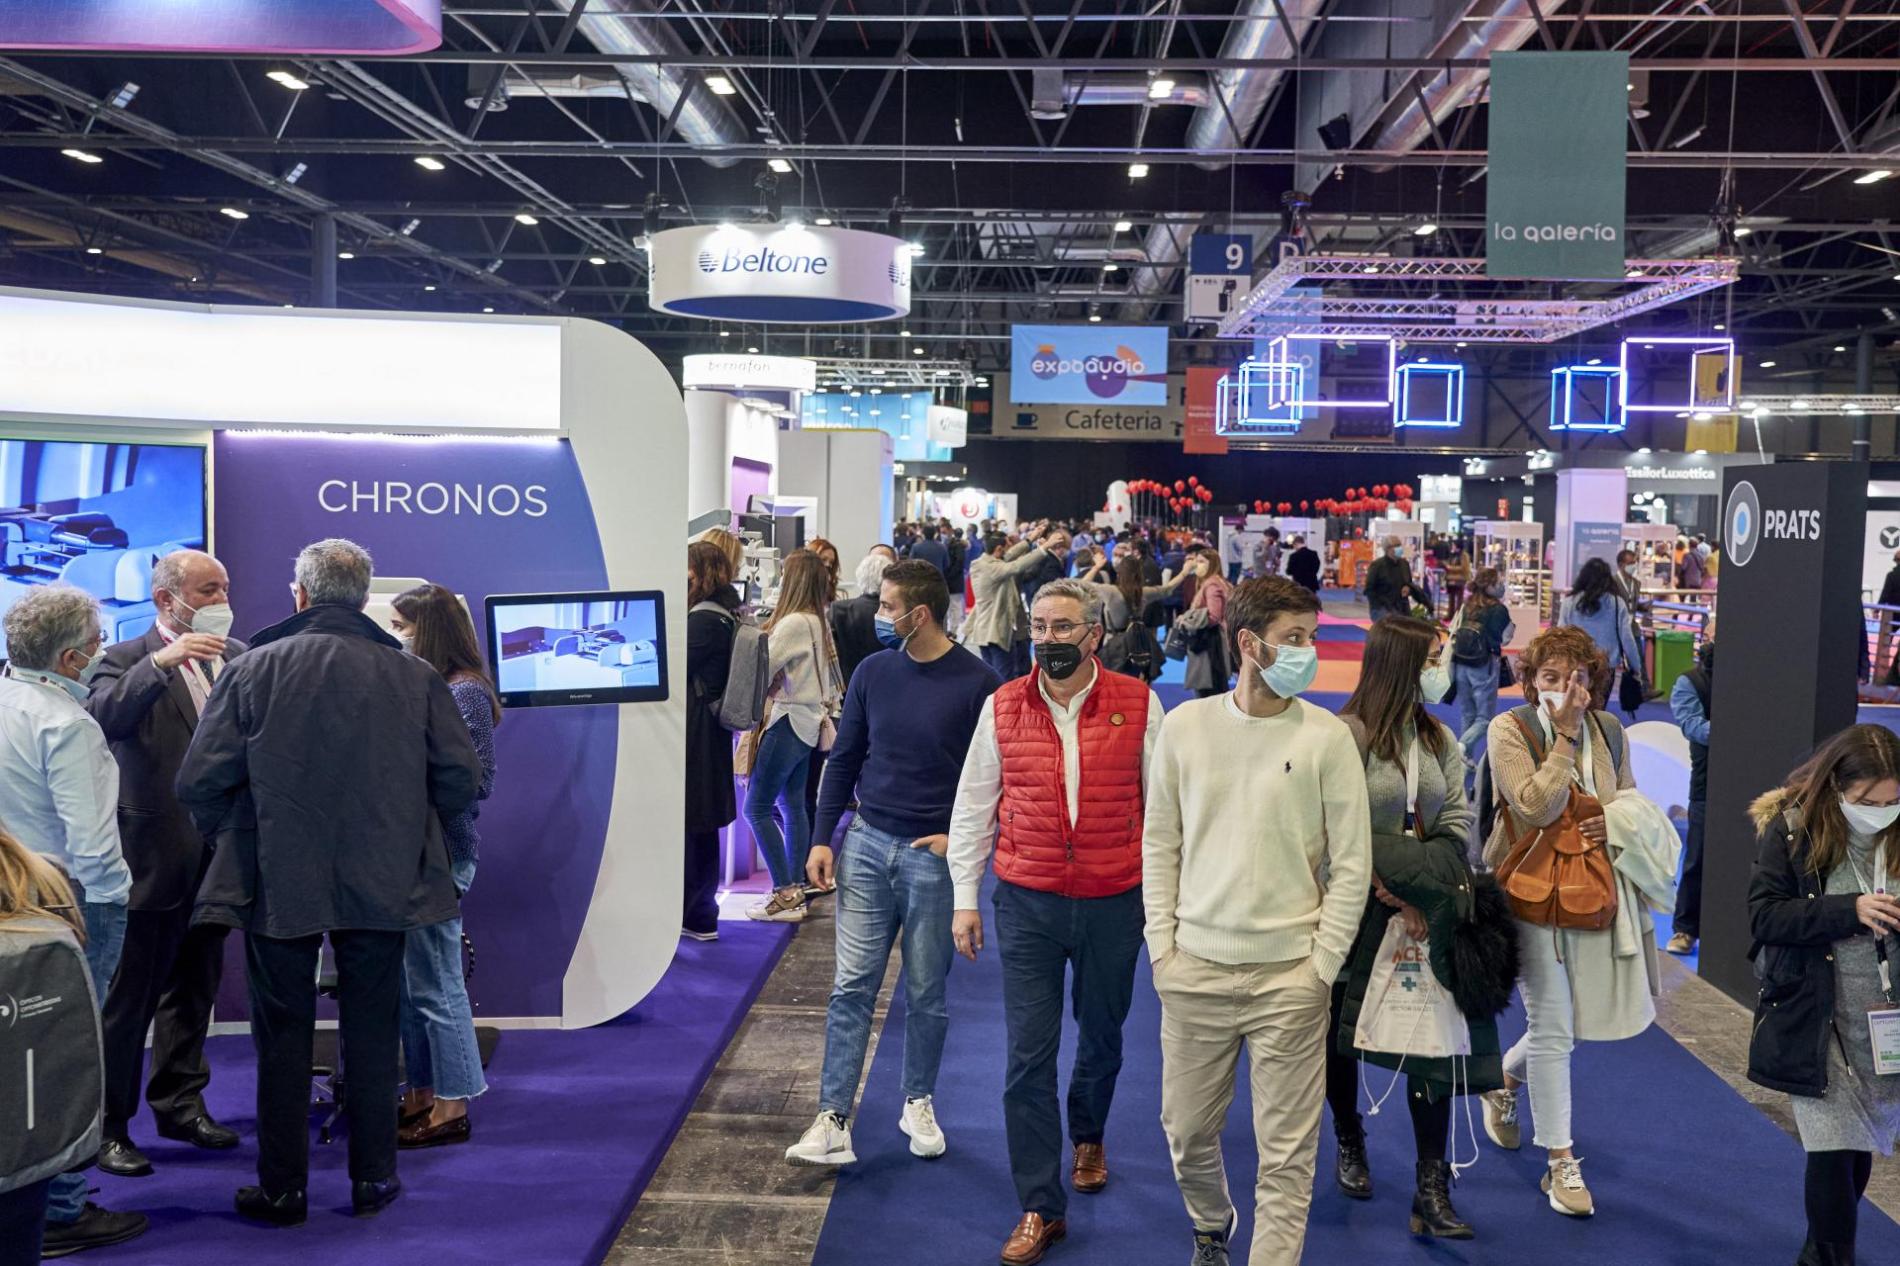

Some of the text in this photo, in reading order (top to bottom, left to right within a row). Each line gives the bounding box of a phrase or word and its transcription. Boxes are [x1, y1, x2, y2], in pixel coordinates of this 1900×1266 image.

[1494, 222, 1516, 240] la
[721, 247, 828, 275] Beltone
[1225, 243, 1244, 270] 9
[1065, 408, 1162, 431] Cafeteria
[318, 479, 548, 517] CHRONOS
[1764, 509, 1821, 540] PRATS
